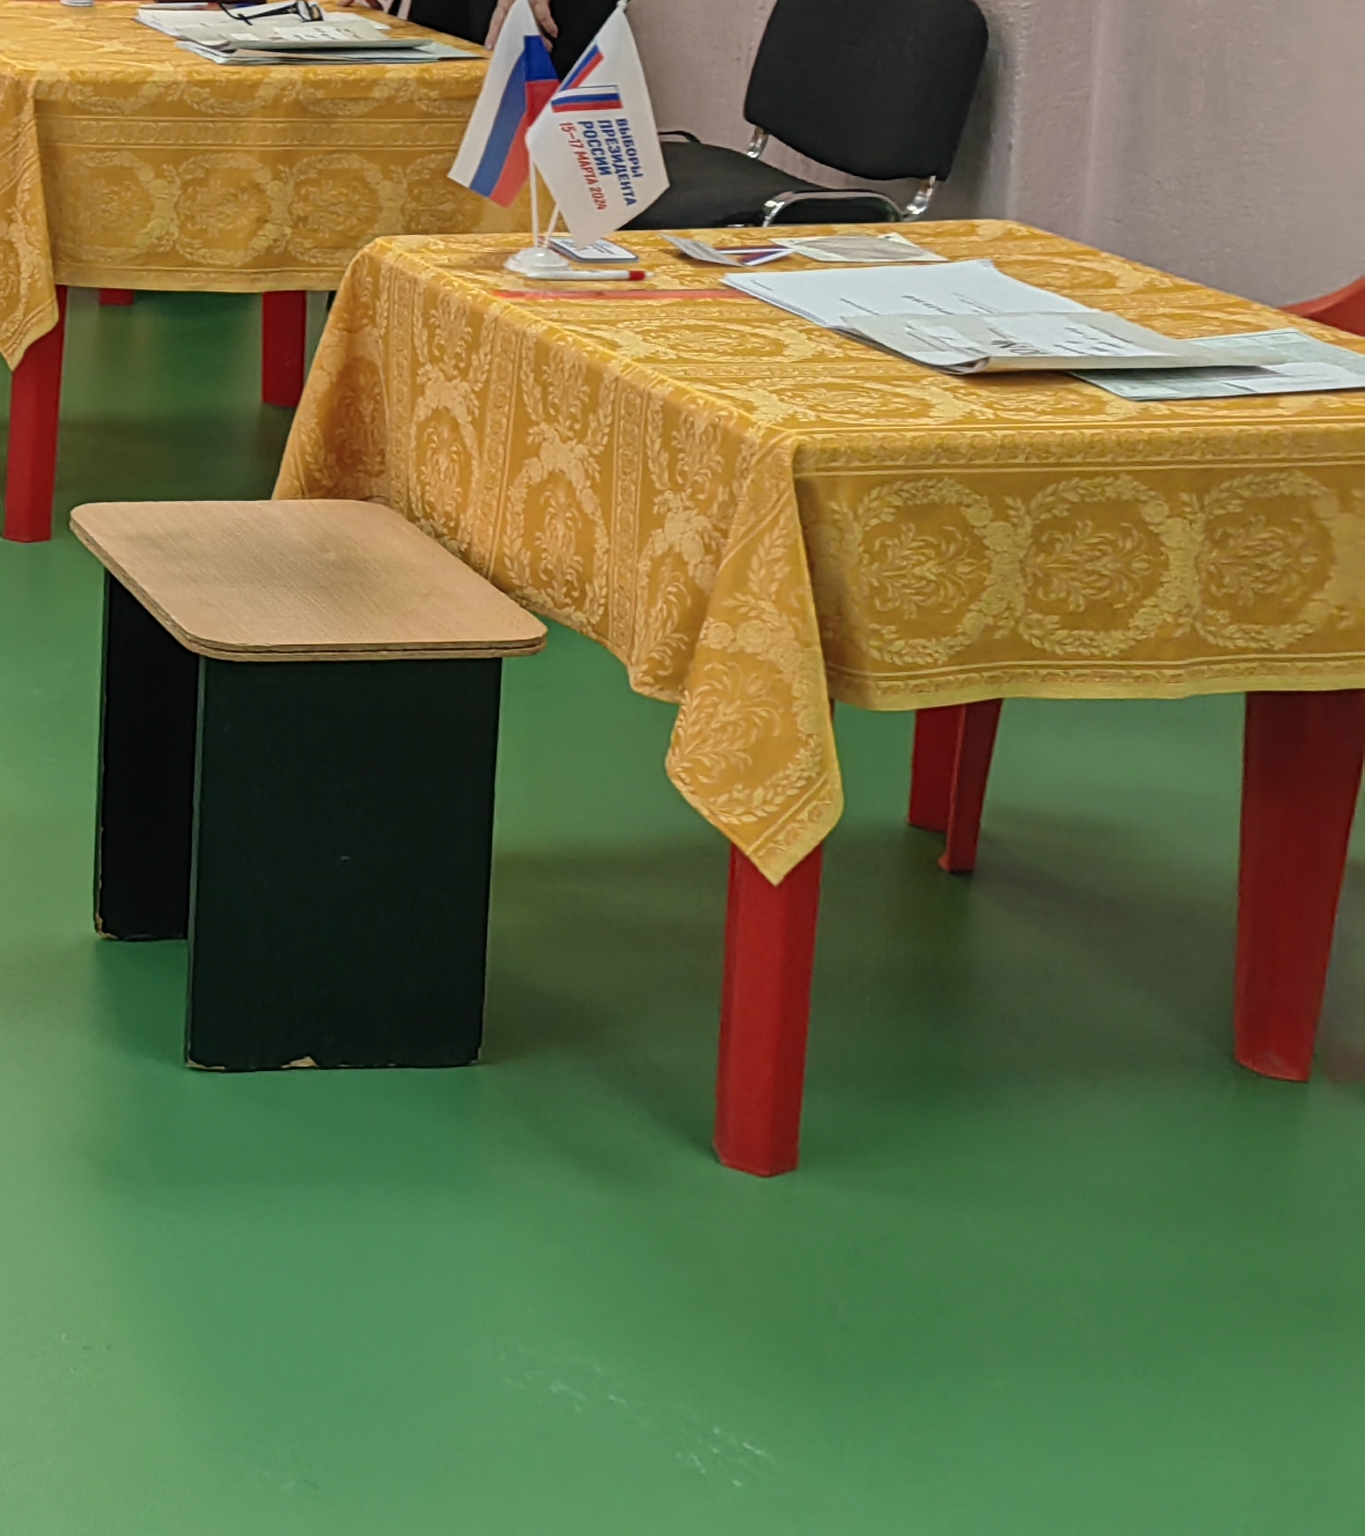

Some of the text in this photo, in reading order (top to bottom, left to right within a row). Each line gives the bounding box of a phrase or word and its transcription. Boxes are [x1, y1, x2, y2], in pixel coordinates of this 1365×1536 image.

[578, 120, 613, 176] РОССИИ
[597, 119, 638, 207] ПРЕЗИДЕНТА
[615, 118, 644, 178] ВЫБОРЫ
[574, 151, 598, 186] МАРТА
[589, 186, 608, 211] 2024
